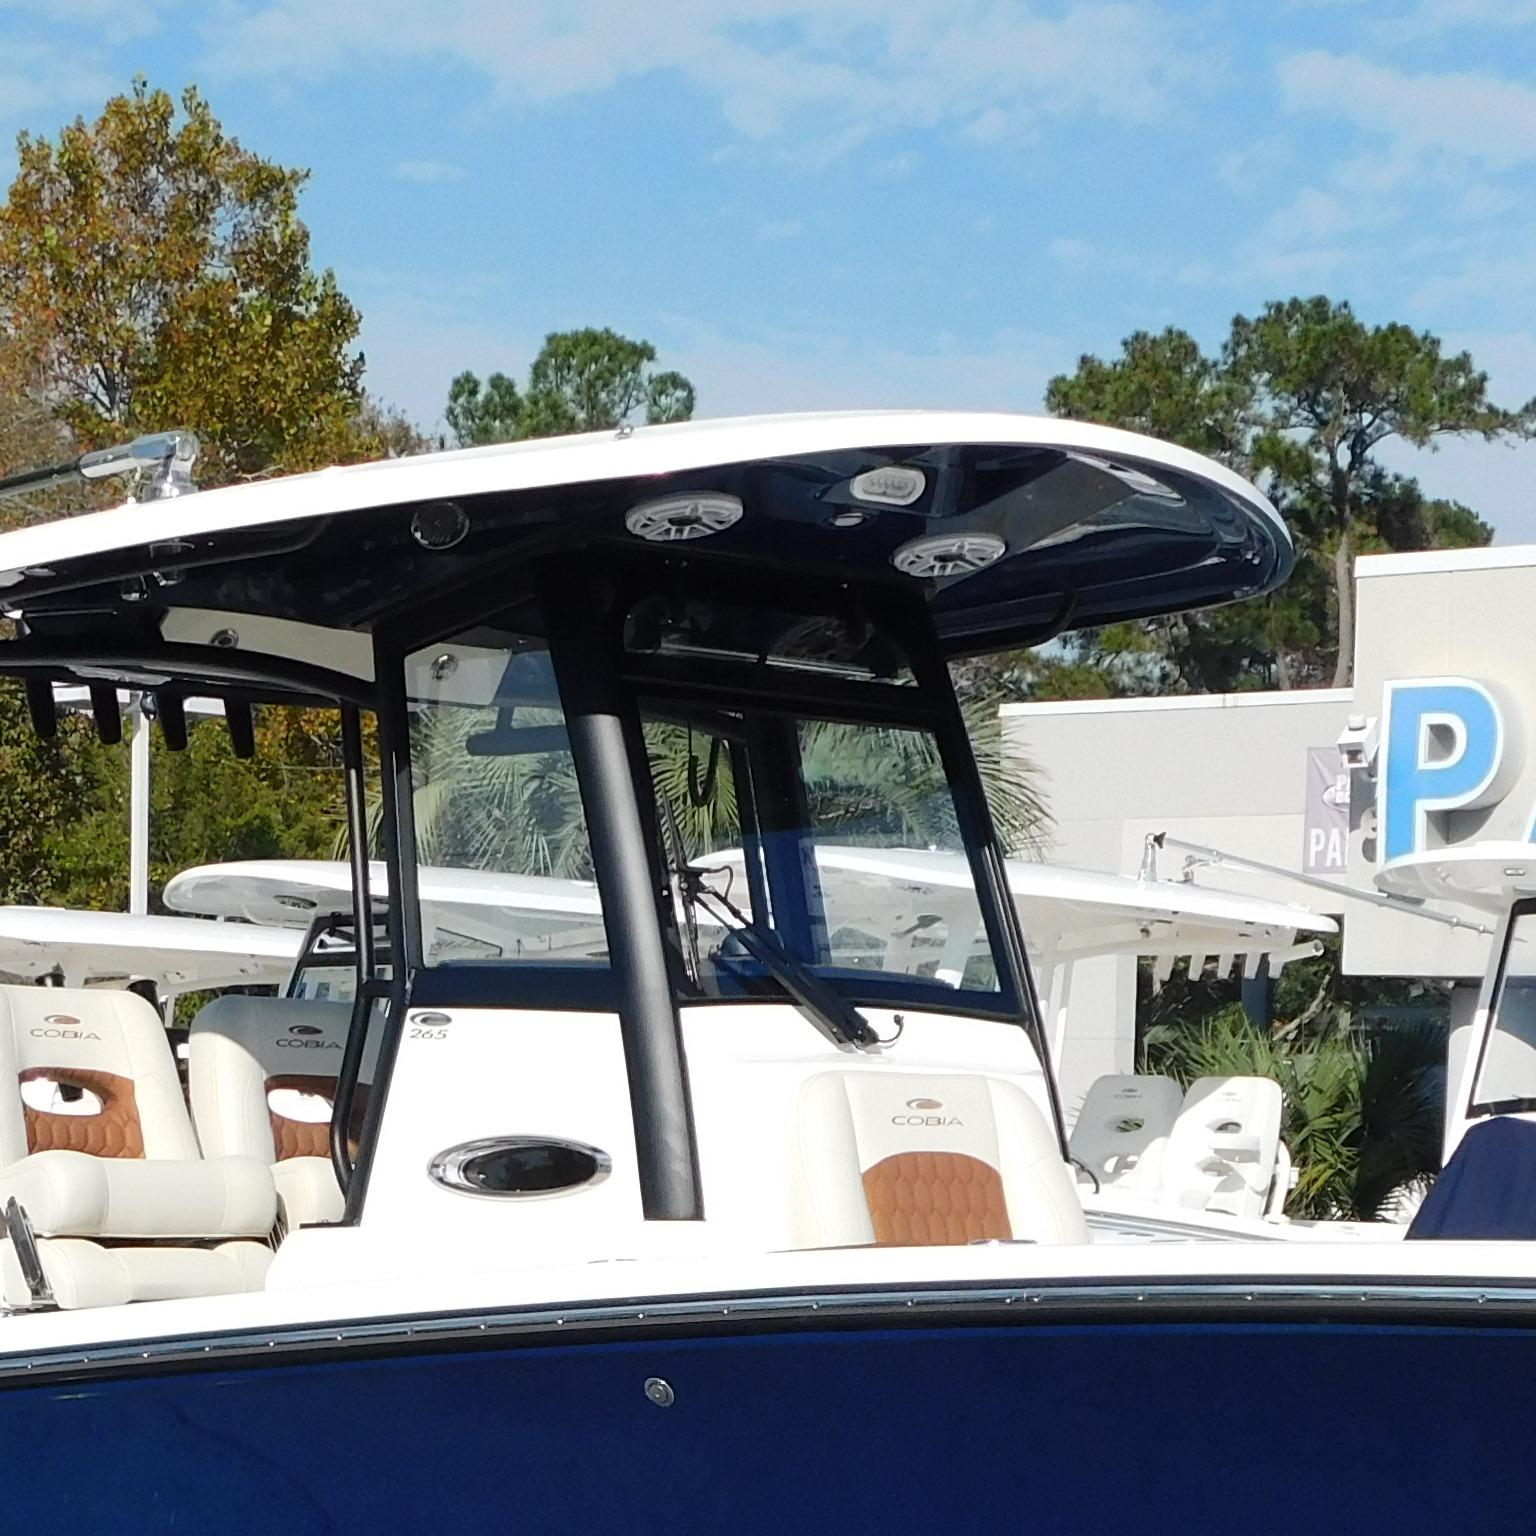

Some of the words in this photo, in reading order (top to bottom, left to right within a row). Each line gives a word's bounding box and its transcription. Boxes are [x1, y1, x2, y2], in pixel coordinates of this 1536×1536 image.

[30, 1027, 102, 1041] COBIA
[409, 1028, 448, 1040] 265
[275, 1038, 343, 1050] COBIA
[891, 1115, 964, 1127] COBIA
